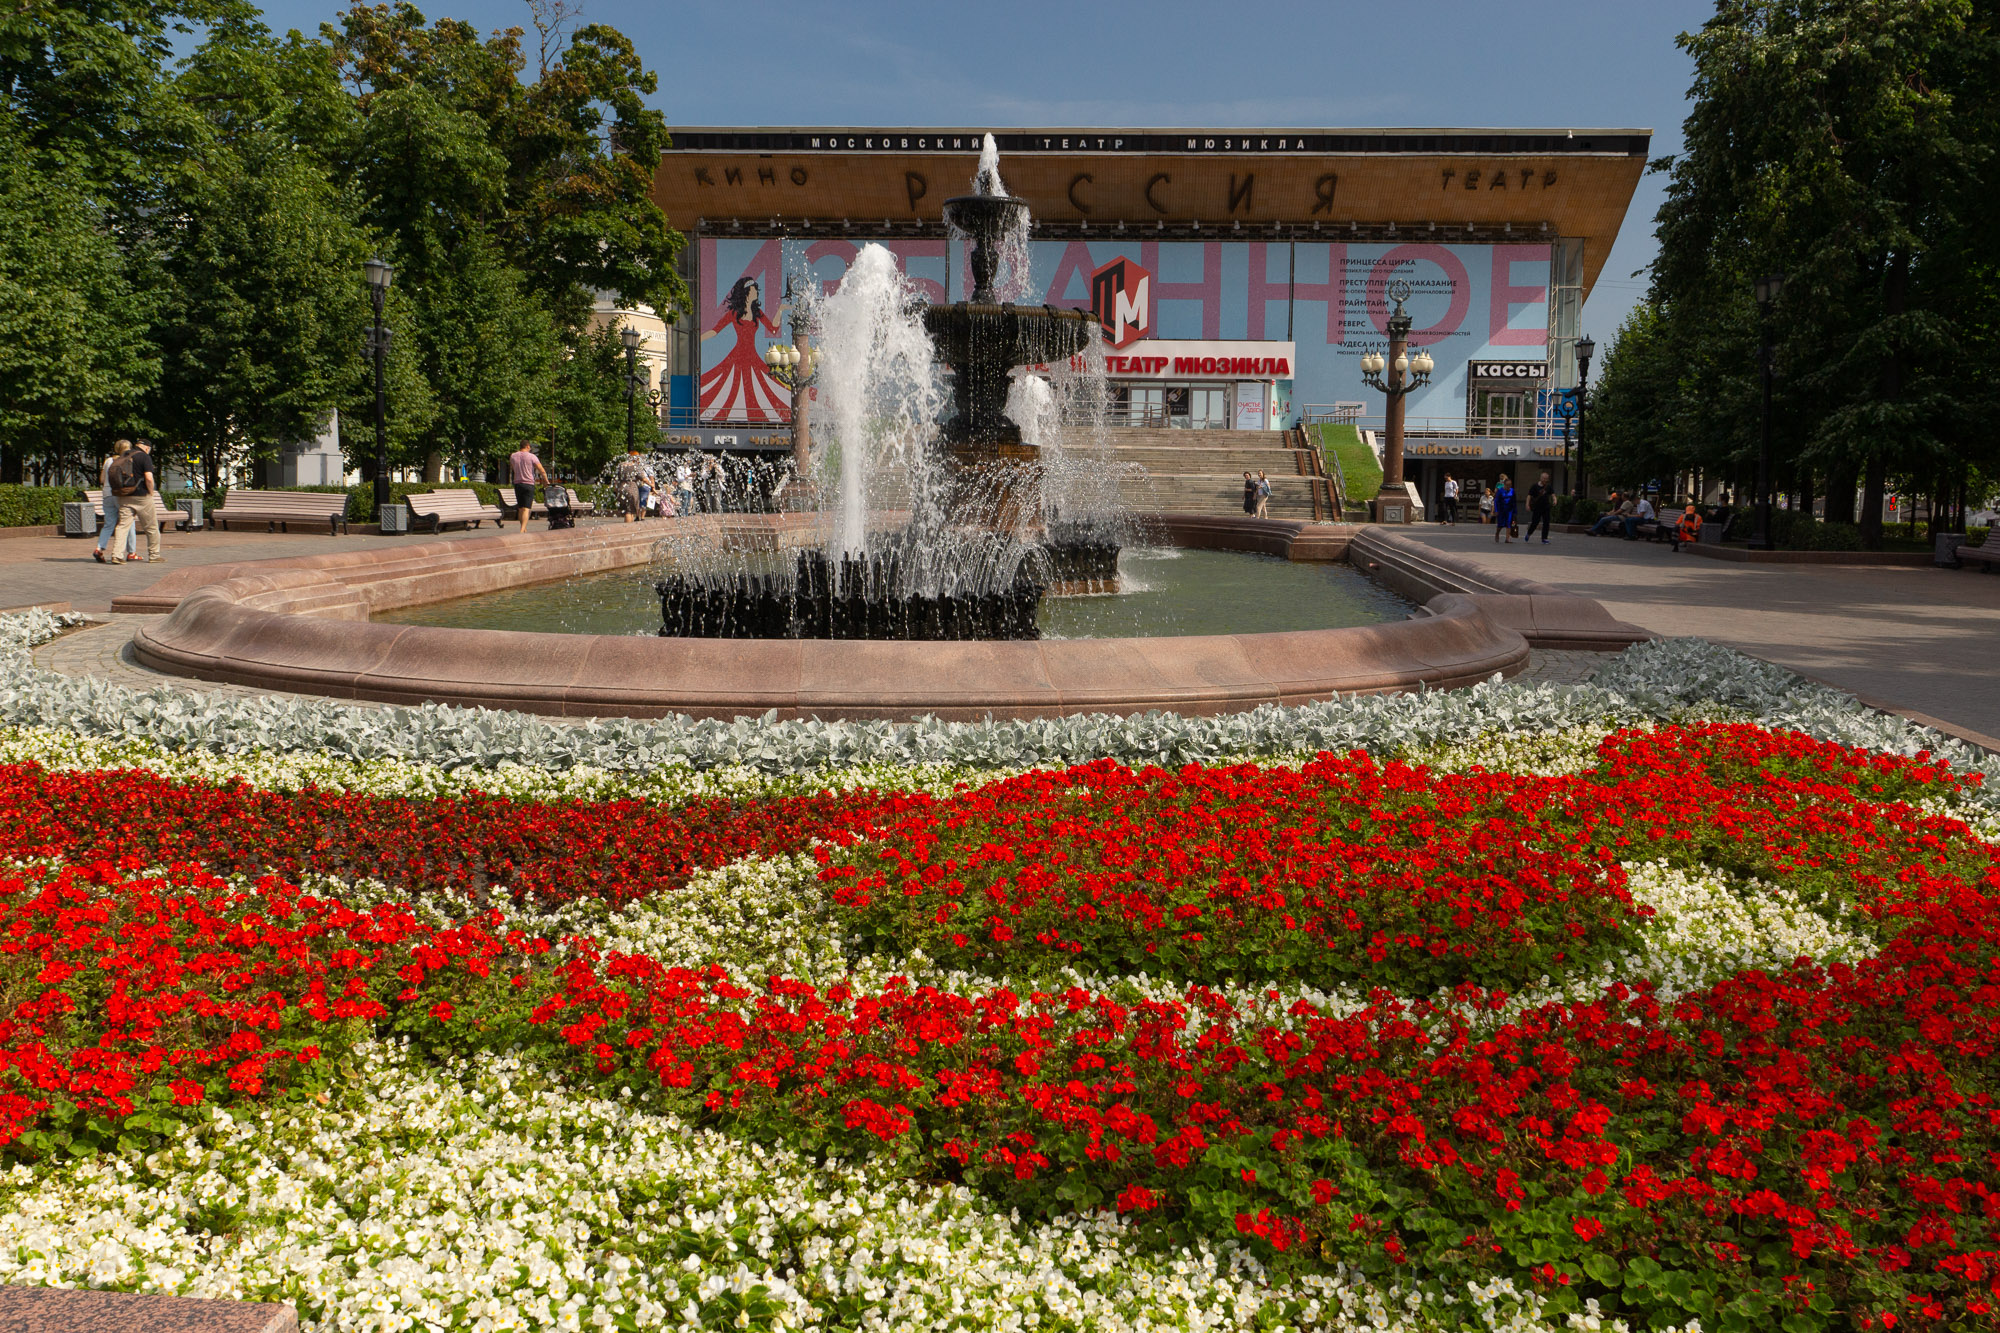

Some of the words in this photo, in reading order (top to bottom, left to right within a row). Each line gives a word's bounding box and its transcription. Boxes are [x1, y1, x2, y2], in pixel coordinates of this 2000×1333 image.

[811, 138, 979, 149] МОСКОВСКИЙ
[1044, 138, 1124, 149] ТЕАТР
[1187, 139, 1305, 149] МЮЗИКЛА
[694, 167, 808, 187] КИНО
[905, 170, 1338, 216] РССИЯ
[1442, 168, 1557, 191] ТЕАТР
[1340, 258, 1387, 266] ПРИНЦЕССА
[1338, 299, 1389, 307] ПРАЙМТАЙМ
[1106, 355, 1169, 374] ТЕАТР
[1174, 356, 1290, 375] МЮЗИКЛА
[1406, 441, 1484, 456] ЧАЙХОНА
